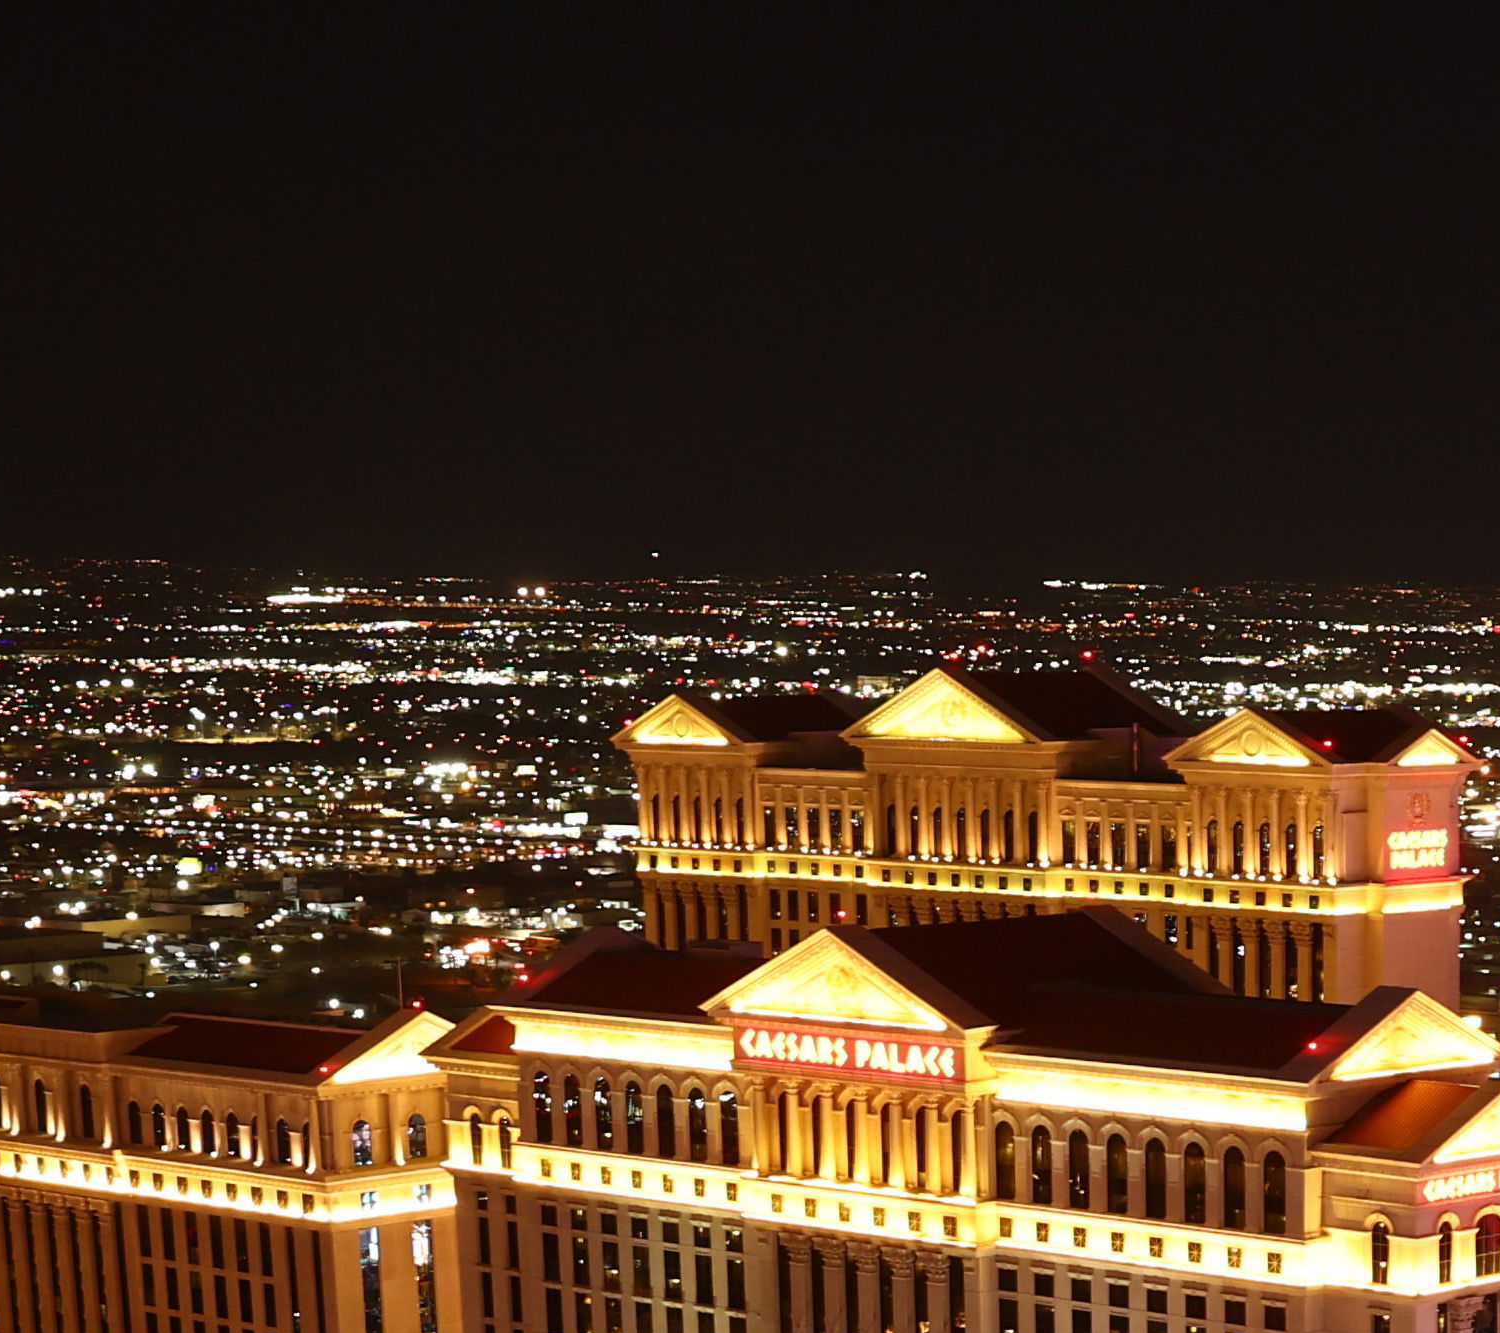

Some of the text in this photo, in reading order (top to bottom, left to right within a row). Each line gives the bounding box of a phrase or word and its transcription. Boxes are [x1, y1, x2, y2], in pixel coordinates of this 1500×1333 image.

[1387, 828, 1448, 850] CAESARS
[1389, 848, 1445, 870] PALACE
[740, 1028, 956, 1078] CAESARS PALACE
[1423, 1170, 1496, 1202] CAESARS
